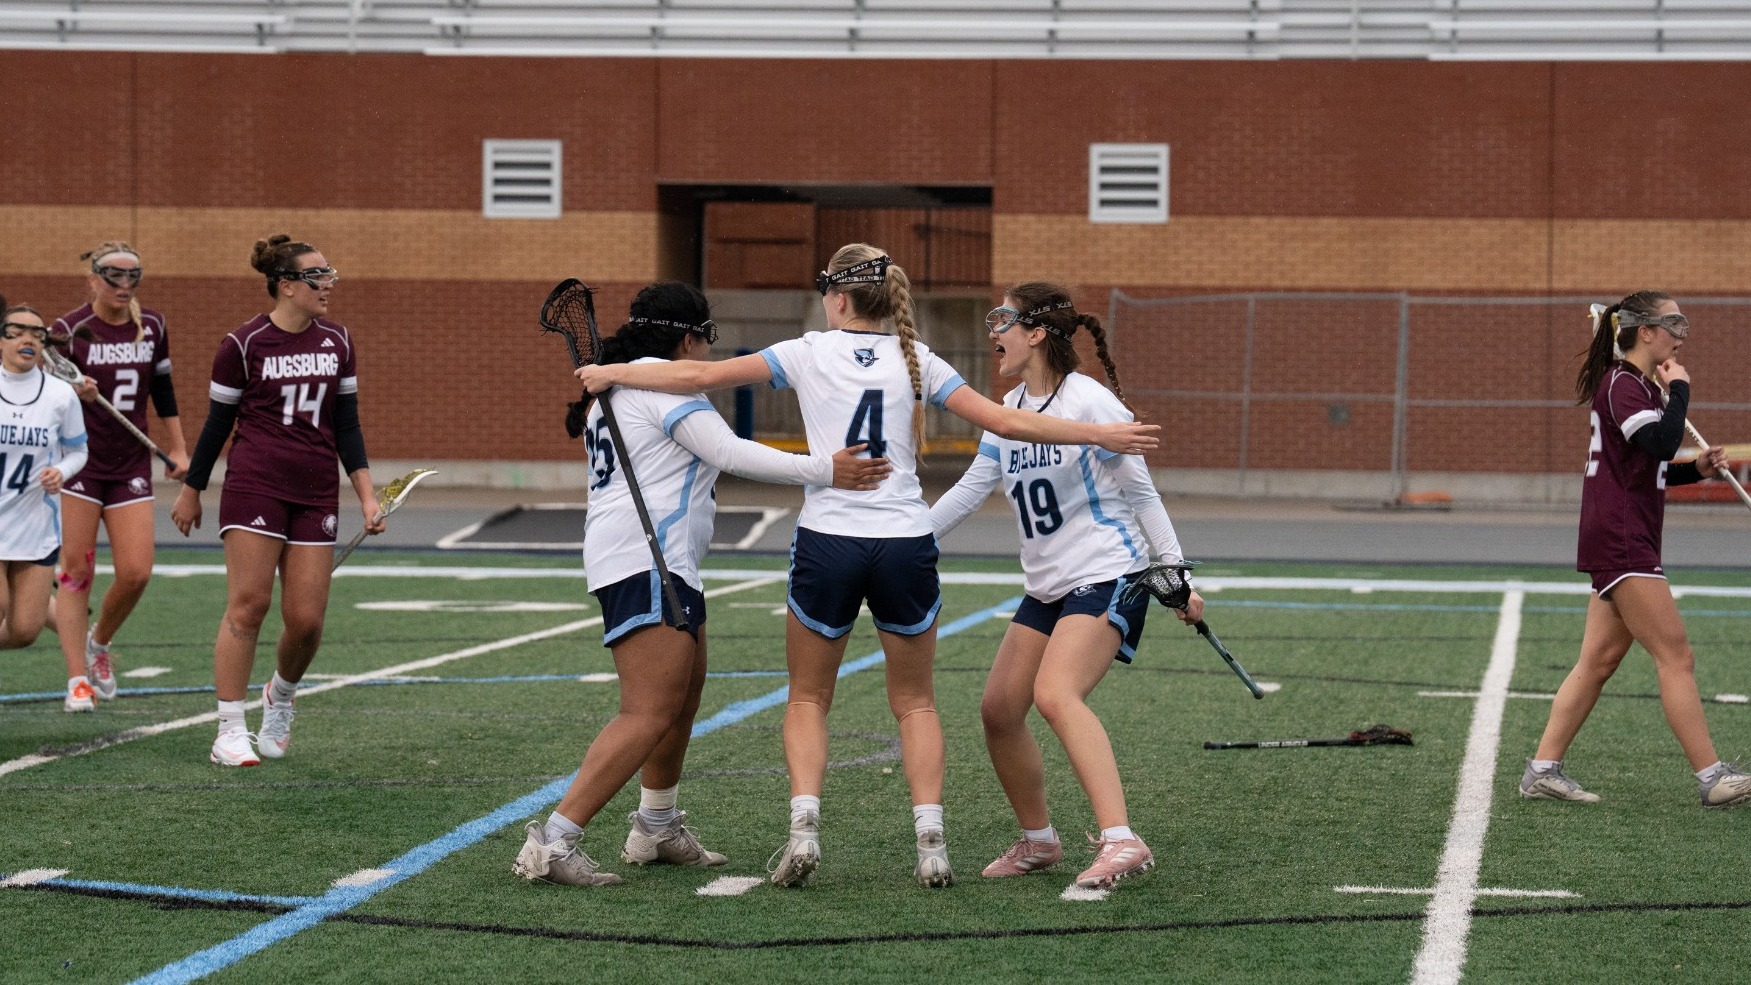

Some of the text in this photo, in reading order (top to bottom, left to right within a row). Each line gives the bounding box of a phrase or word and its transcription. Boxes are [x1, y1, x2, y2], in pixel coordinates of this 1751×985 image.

[831, 270, 848, 280] GAIT
[850, 262, 869, 272] GAIT
[1029, 306, 1051, 317] STX
[673, 321, 690, 329] GAIT
[1040, 322, 1060, 335] STX
[86, 341, 155, 365] AUGSBURG
[261, 352, 339, 381] AUGSBURG
[112, 368, 139, 411] 2
[281, 383, 327, 428] 14
[0, 424, 49, 448] UEJAYS
[845, 388, 888, 459] 4
[1007, 443, 1062, 474] BEJAYS
[1011, 478, 1064, 539] 19
